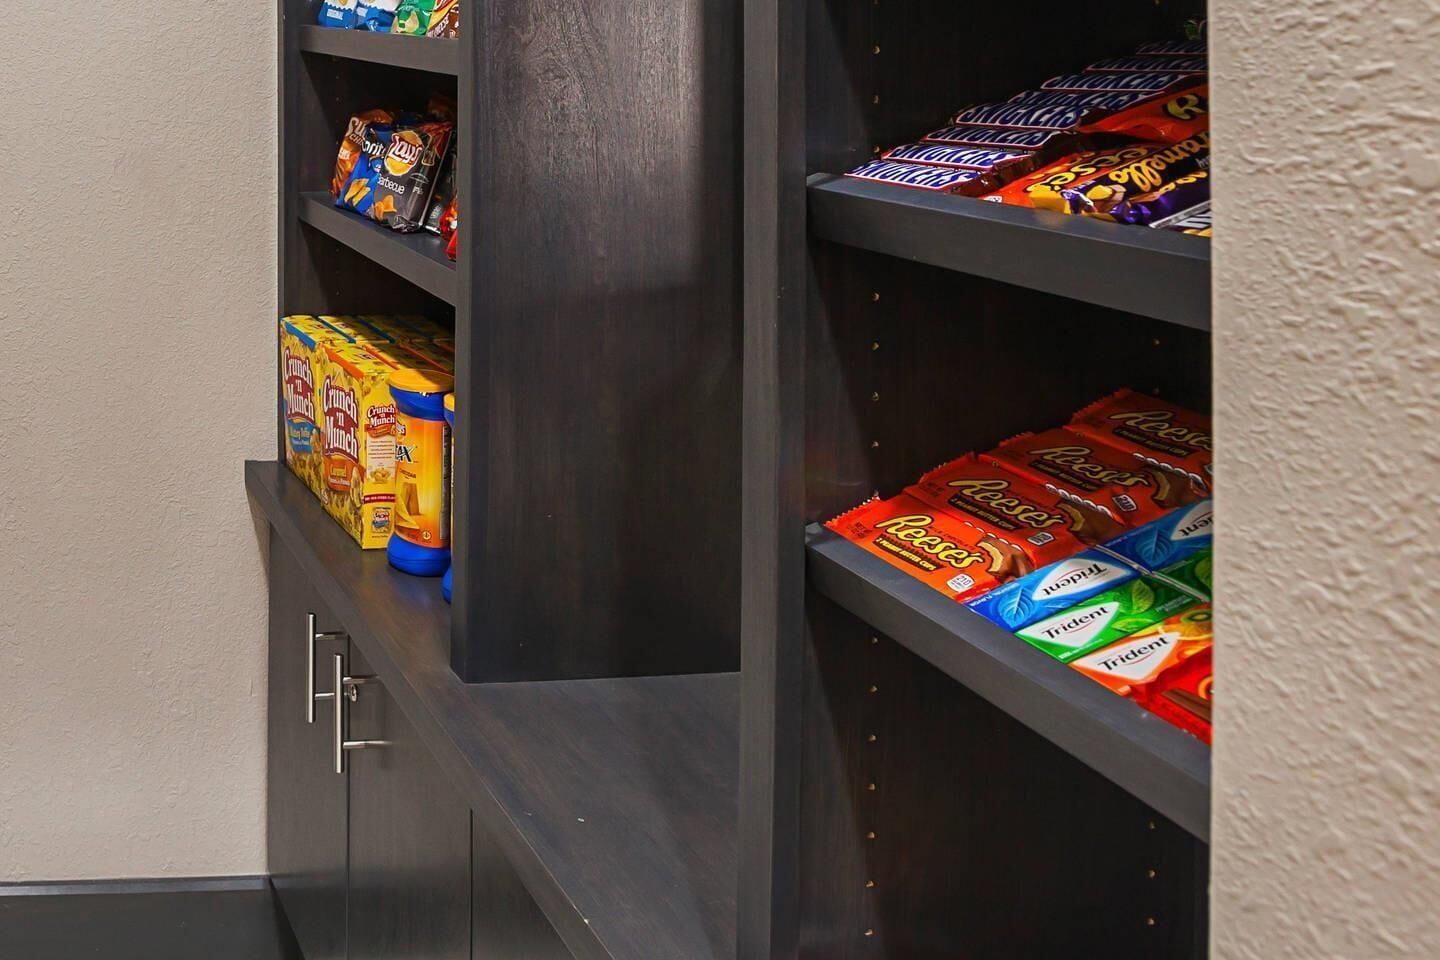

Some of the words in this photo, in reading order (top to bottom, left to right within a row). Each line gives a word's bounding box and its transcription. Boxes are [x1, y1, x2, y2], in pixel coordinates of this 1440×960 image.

[959, 102, 1080, 128] SNICKERS
[388, 134, 423, 165] Lay's
[889, 143, 1008, 167] SNICKERS
[854, 161, 976, 188] SNICKERS
[284, 346, 314, 389] Crunch
[287, 383, 315, 422] Munch
[323, 377, 358, 420] Crunch
[367, 405, 396, 420] Crunch
[325, 415, 359, 461] Munch
[368, 415, 396, 429] Munch
[1028, 446, 1150, 487] Reese's
[948, 479, 1066, 528] Reese's
[874, 514, 984, 569] Reese's
[1042, 563, 1108, 597] Trident
[1041, 606, 1109, 641] Trident
[1097, 636, 1170, 672] Trident
